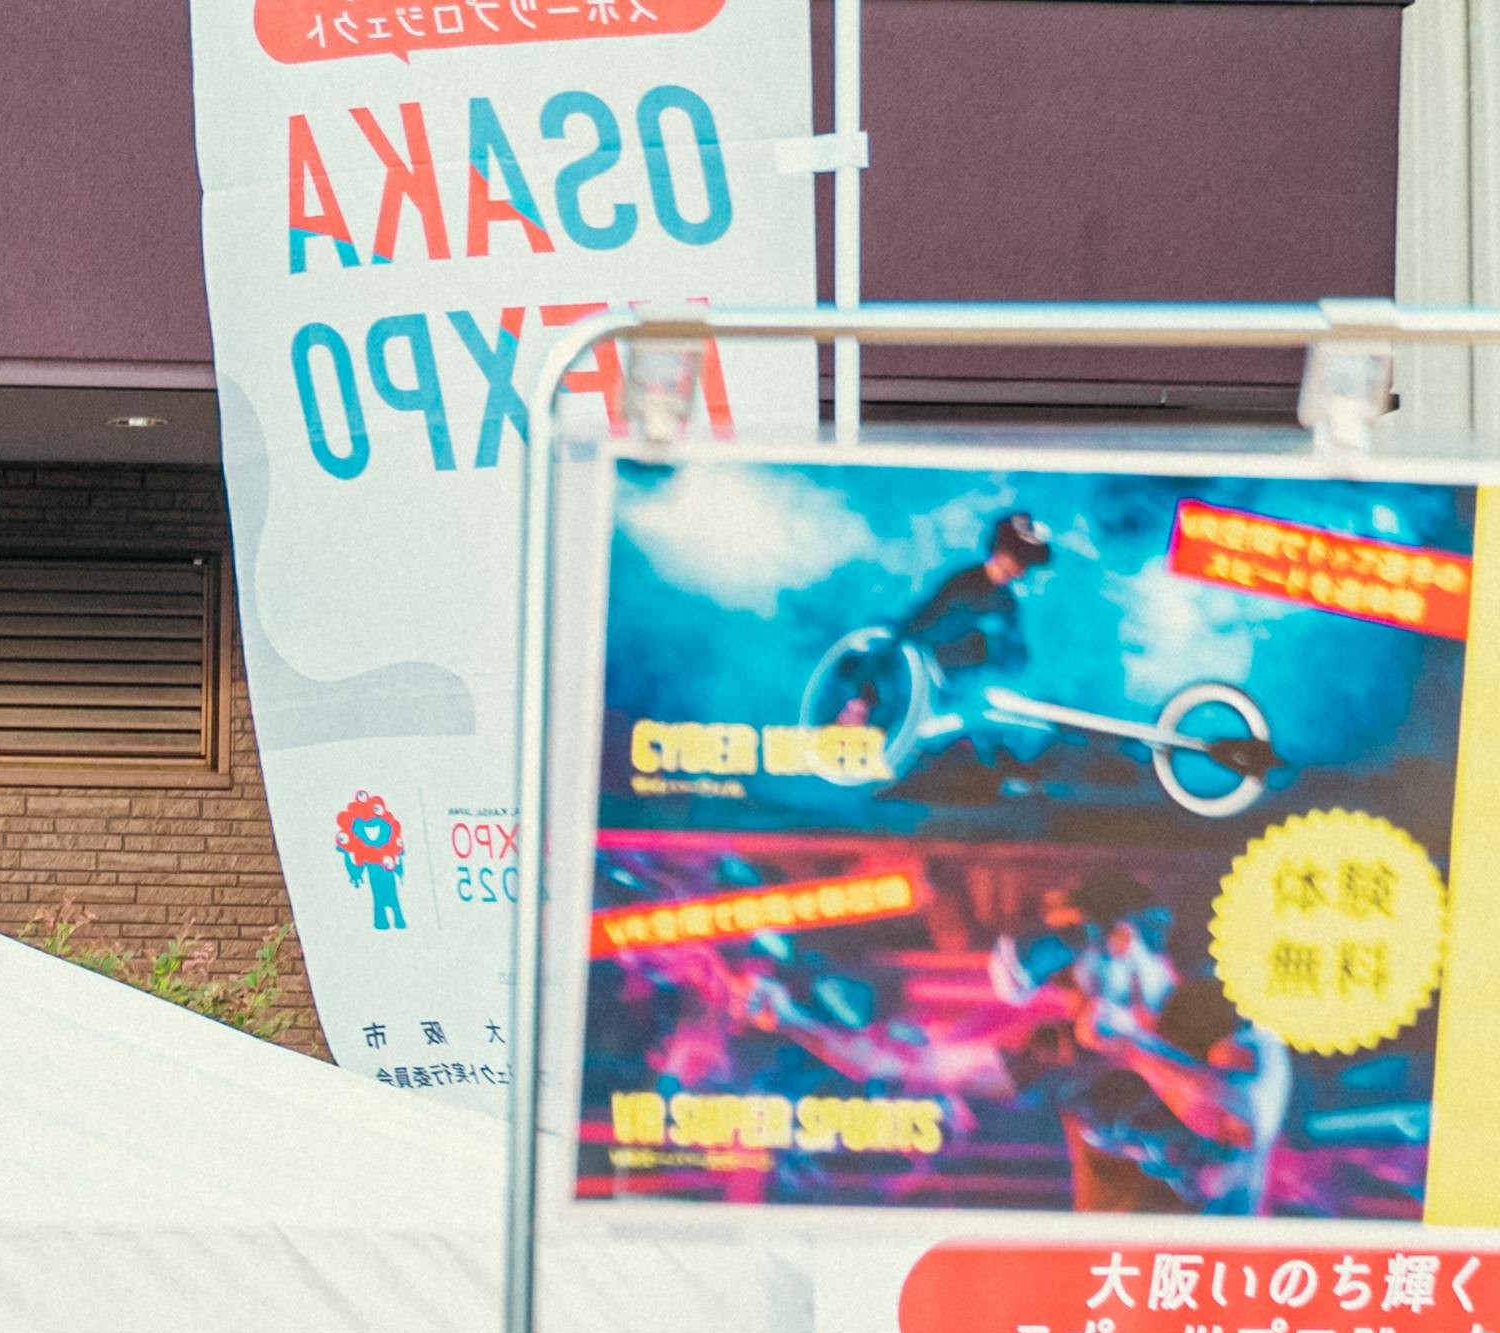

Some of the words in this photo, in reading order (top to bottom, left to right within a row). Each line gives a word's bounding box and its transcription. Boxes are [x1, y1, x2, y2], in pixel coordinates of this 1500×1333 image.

[1087, 1252, 1479, 1315] 大阪いのち輝く
